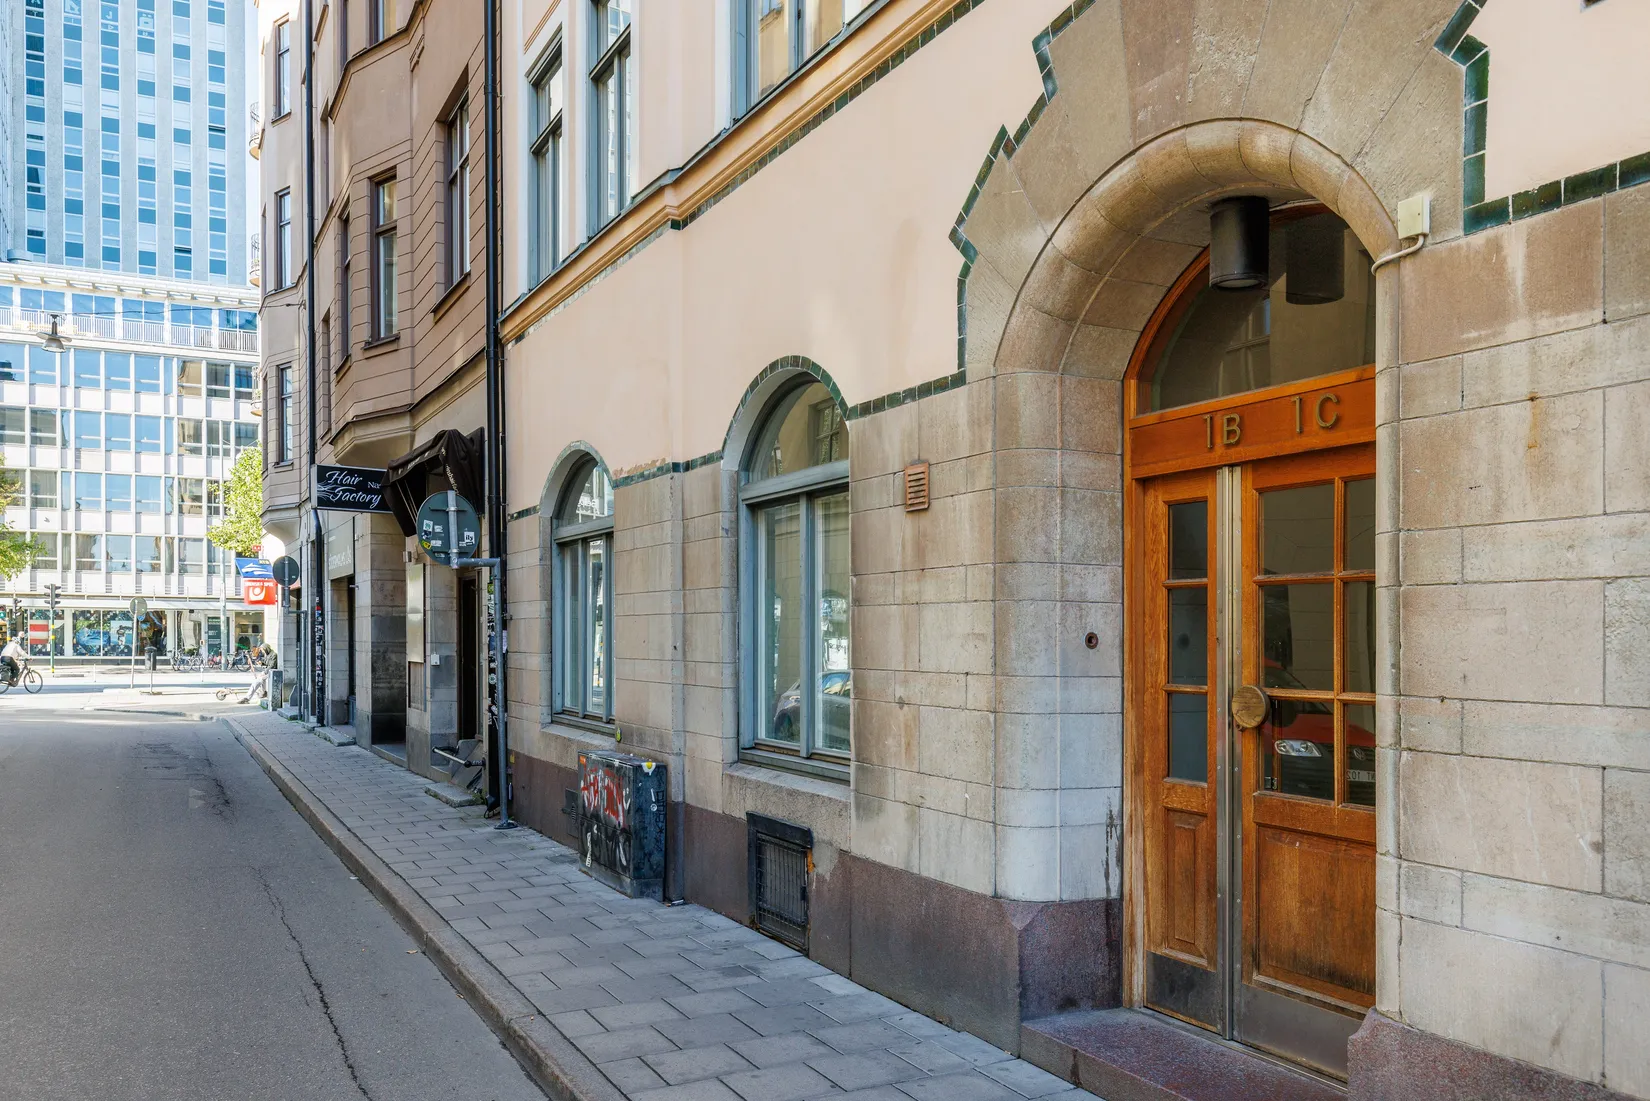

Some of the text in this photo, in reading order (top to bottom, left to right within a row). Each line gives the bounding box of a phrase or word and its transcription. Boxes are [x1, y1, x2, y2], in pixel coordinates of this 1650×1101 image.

[1203, 393, 1340, 449] 1B 1C
[326, 470, 363, 485] Hair
[329, 486, 382, 509] Factory
